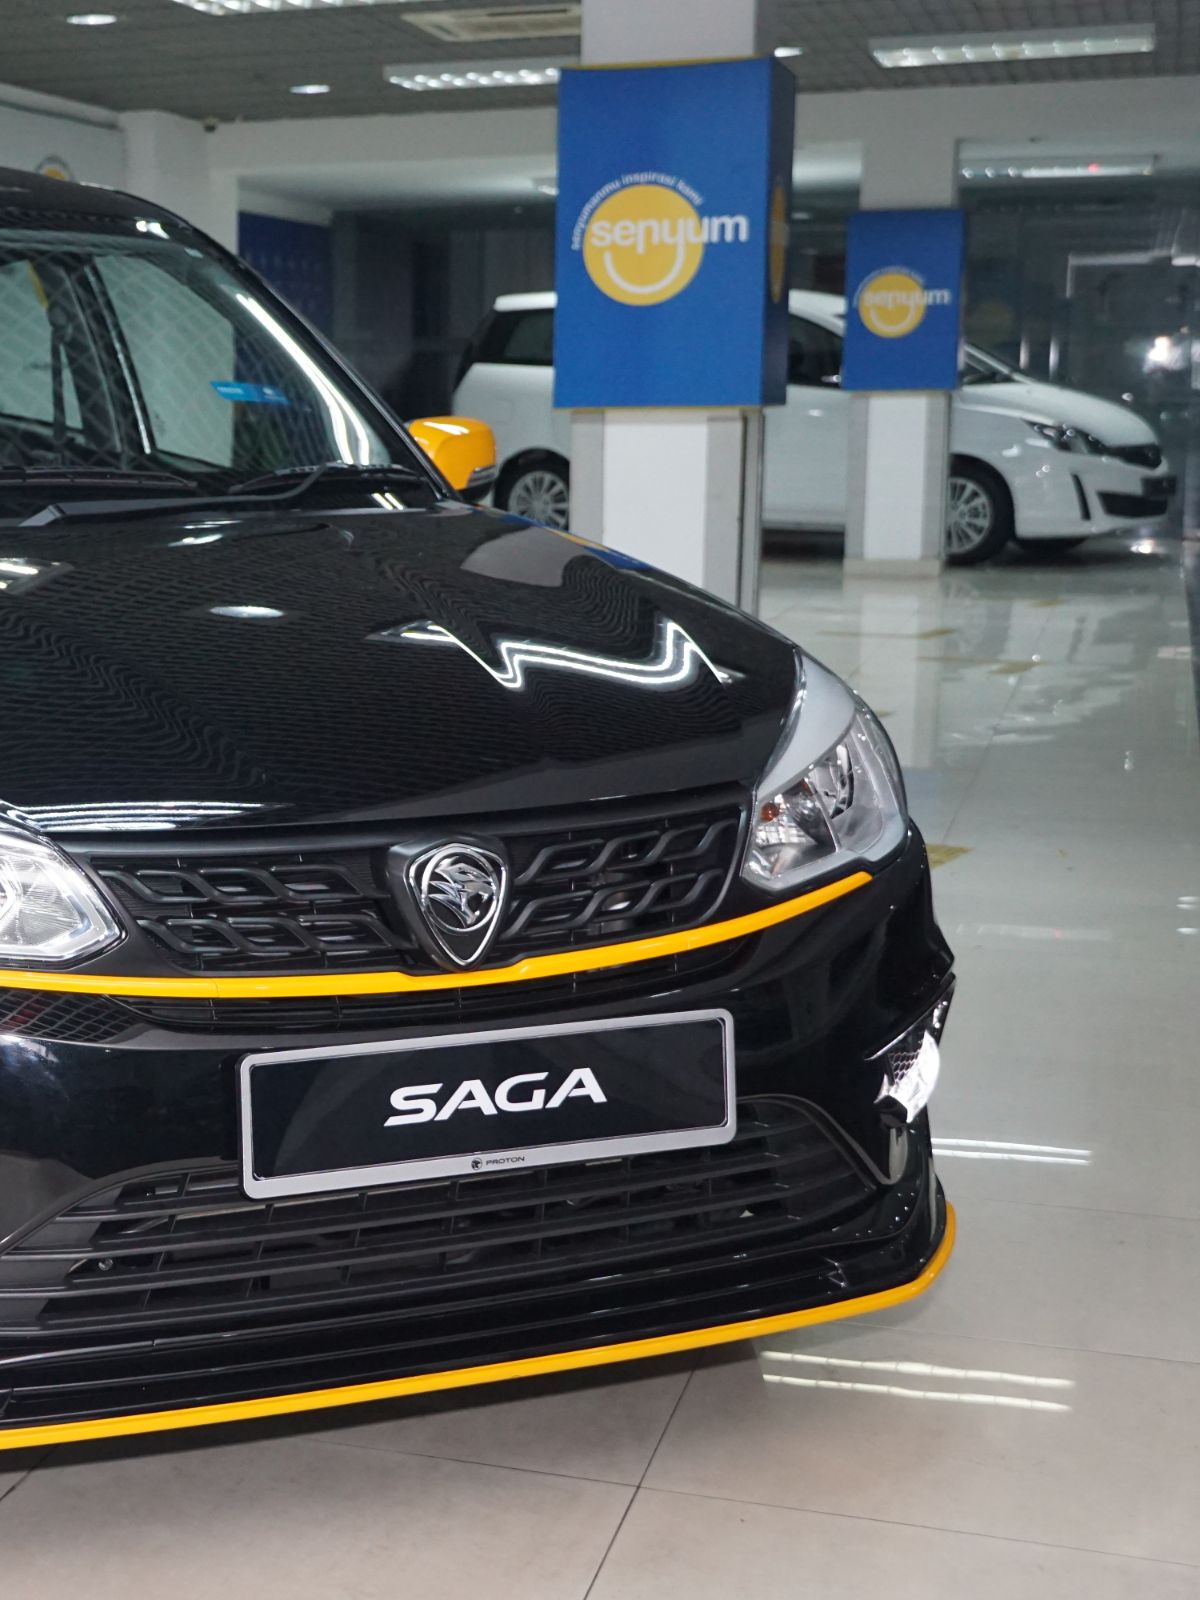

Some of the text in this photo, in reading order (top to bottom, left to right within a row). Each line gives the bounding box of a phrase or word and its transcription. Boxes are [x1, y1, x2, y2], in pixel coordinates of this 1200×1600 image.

[590, 214, 749, 260] senyum
[383, 1067, 608, 1127] SAGA
[485, 1155, 526, 1166] PROTON
